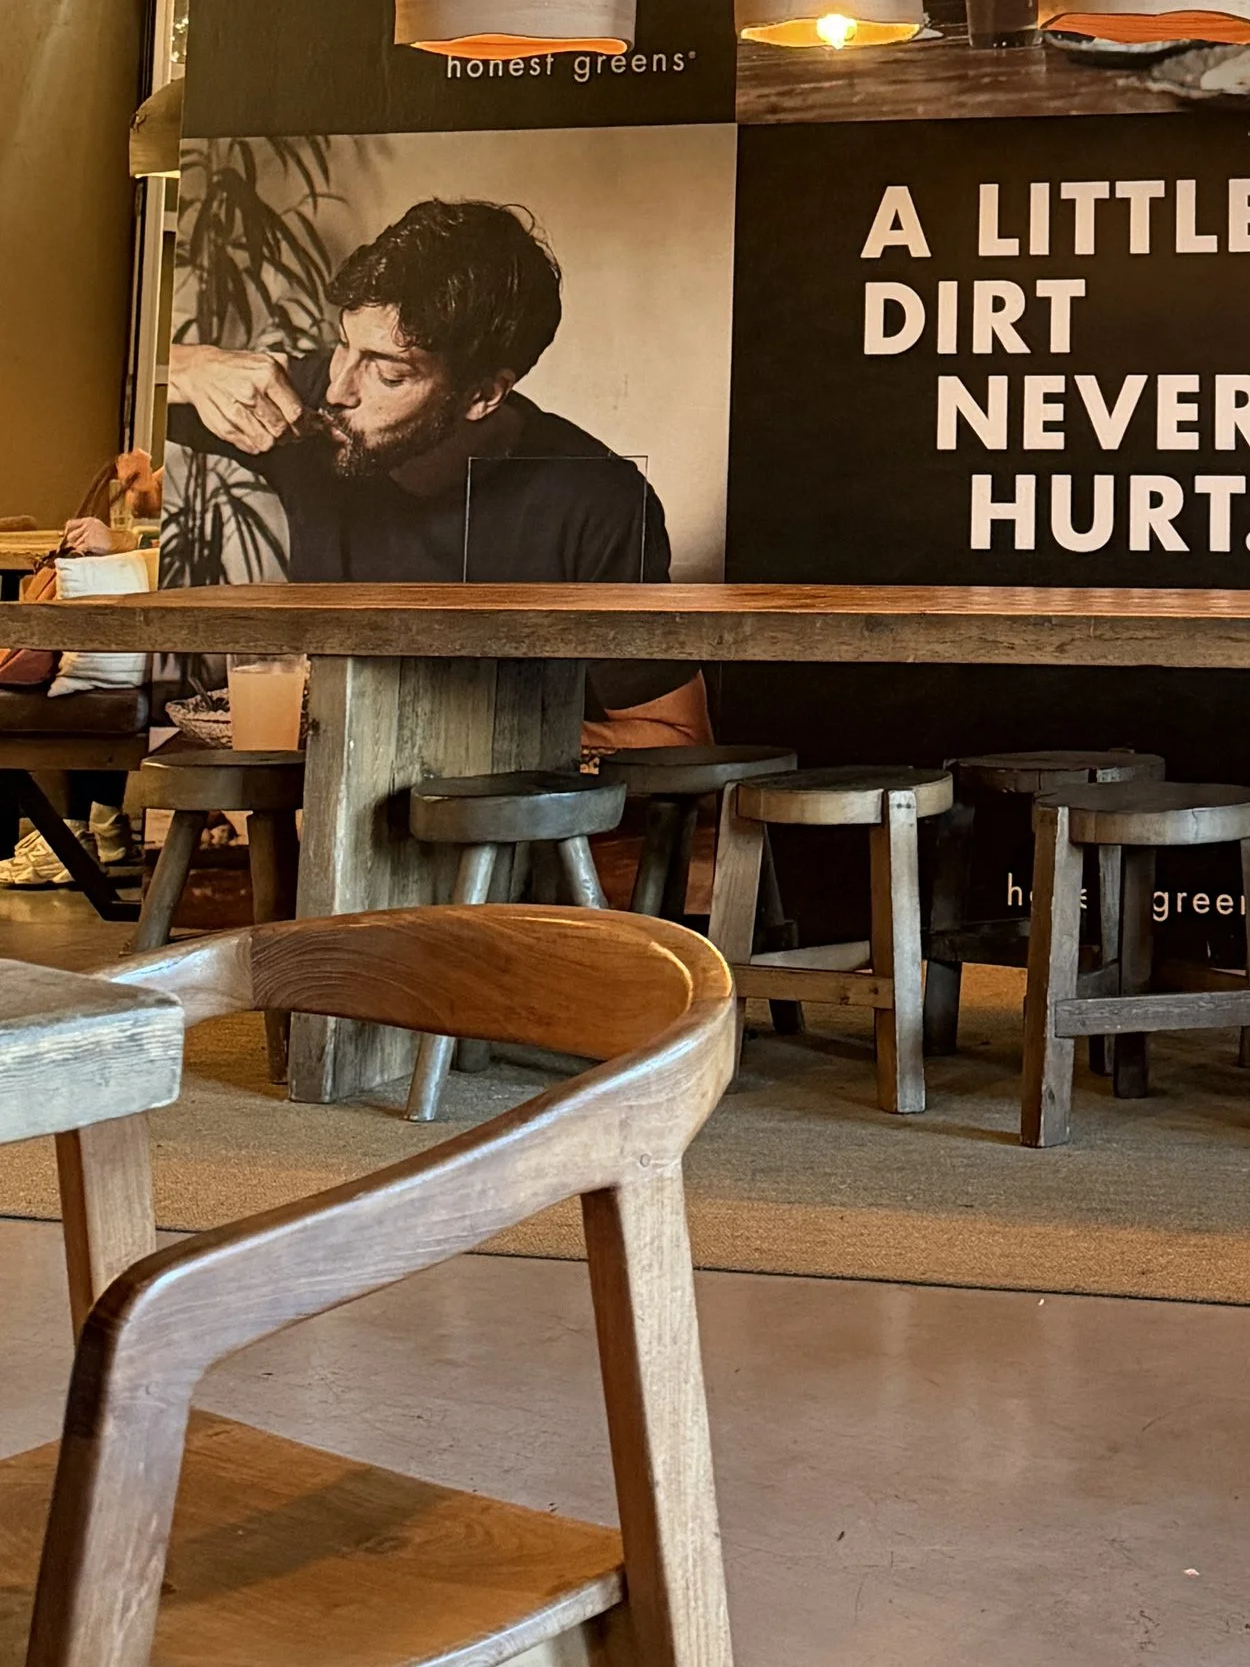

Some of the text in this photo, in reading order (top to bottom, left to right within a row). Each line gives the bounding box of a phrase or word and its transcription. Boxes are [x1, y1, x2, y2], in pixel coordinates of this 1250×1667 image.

[447, 51, 685, 82] honest greens
[860, 185, 932, 259] A
[863, 278, 1086, 355] DIRT
